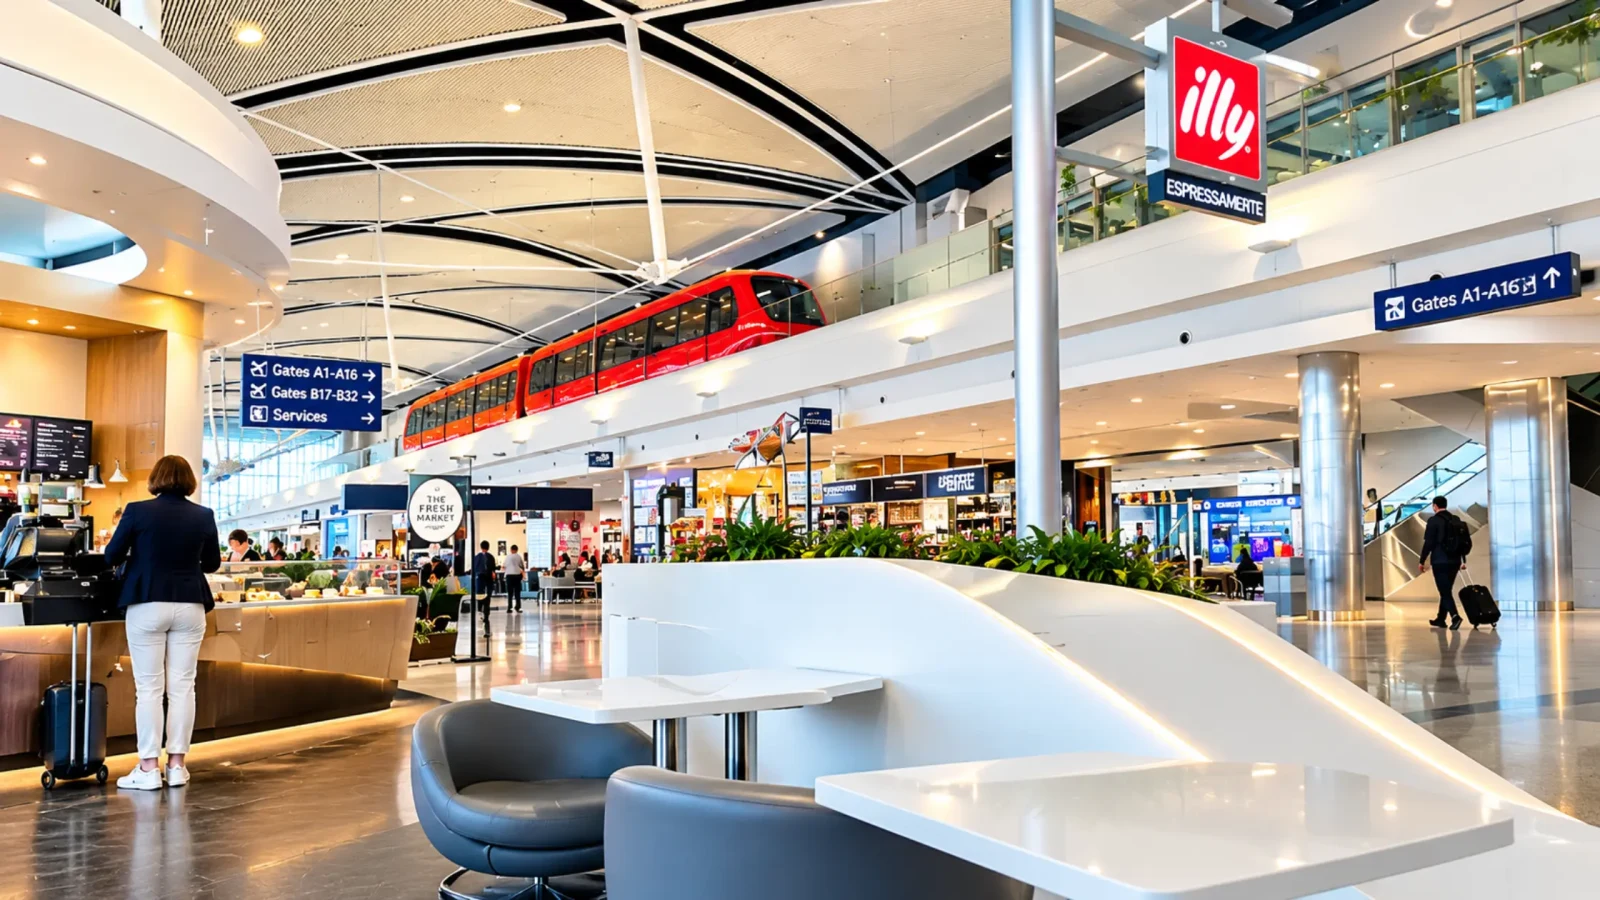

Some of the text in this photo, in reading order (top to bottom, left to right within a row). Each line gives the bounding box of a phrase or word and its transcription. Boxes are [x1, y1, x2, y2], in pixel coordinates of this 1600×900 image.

[1180, 66, 1255, 160] illy
[1411, 278, 1520, 313] Gates A1-A16
[272, 363, 358, 380] Gates A1-A16
[271, 386, 358, 402] Gates B17-B32
[273, 408, 328, 423] Services
[427, 495, 446, 503] THE
[419, 504, 454, 512] FRESH
